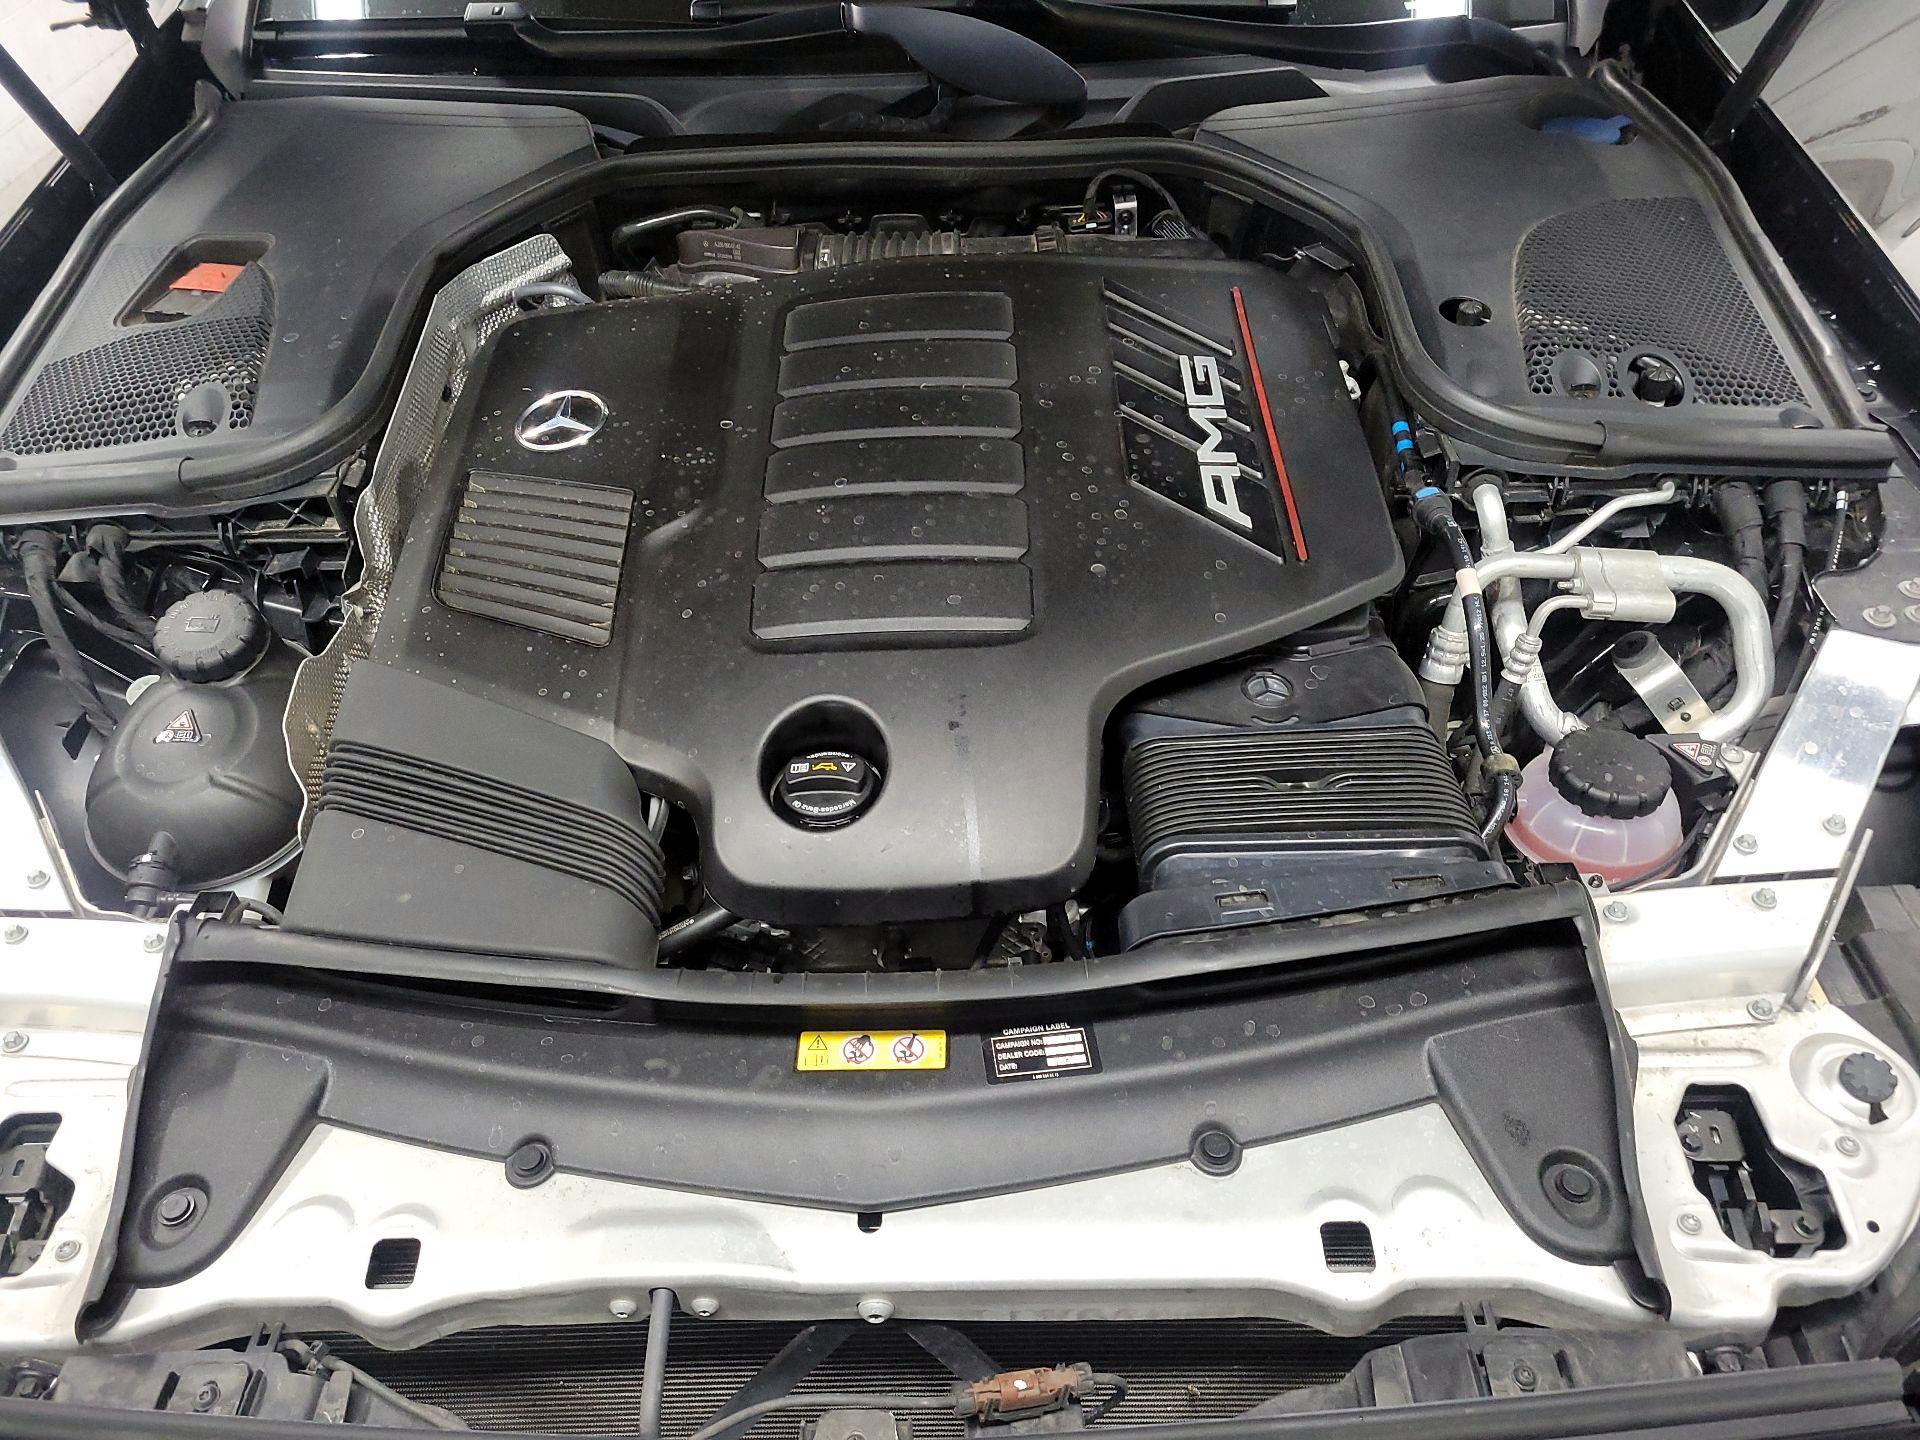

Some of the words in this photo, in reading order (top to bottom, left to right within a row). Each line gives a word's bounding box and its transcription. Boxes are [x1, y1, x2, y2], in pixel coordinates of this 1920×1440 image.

[1179, 355, 1253, 530] AMG
[801, 798, 857, 814] Mercedes-Benz
[1002, 1025, 1044, 1036] CAMPAIGN
[1045, 1022, 1071, 1031] LABEL
[995, 1039, 1030, 1050] CAMPAIGN
[997, 1051, 1023, 1060] DEALER
[1023, 1049, 1045, 1057] CODE:
[999, 1063, 1018, 1071] DATE:
